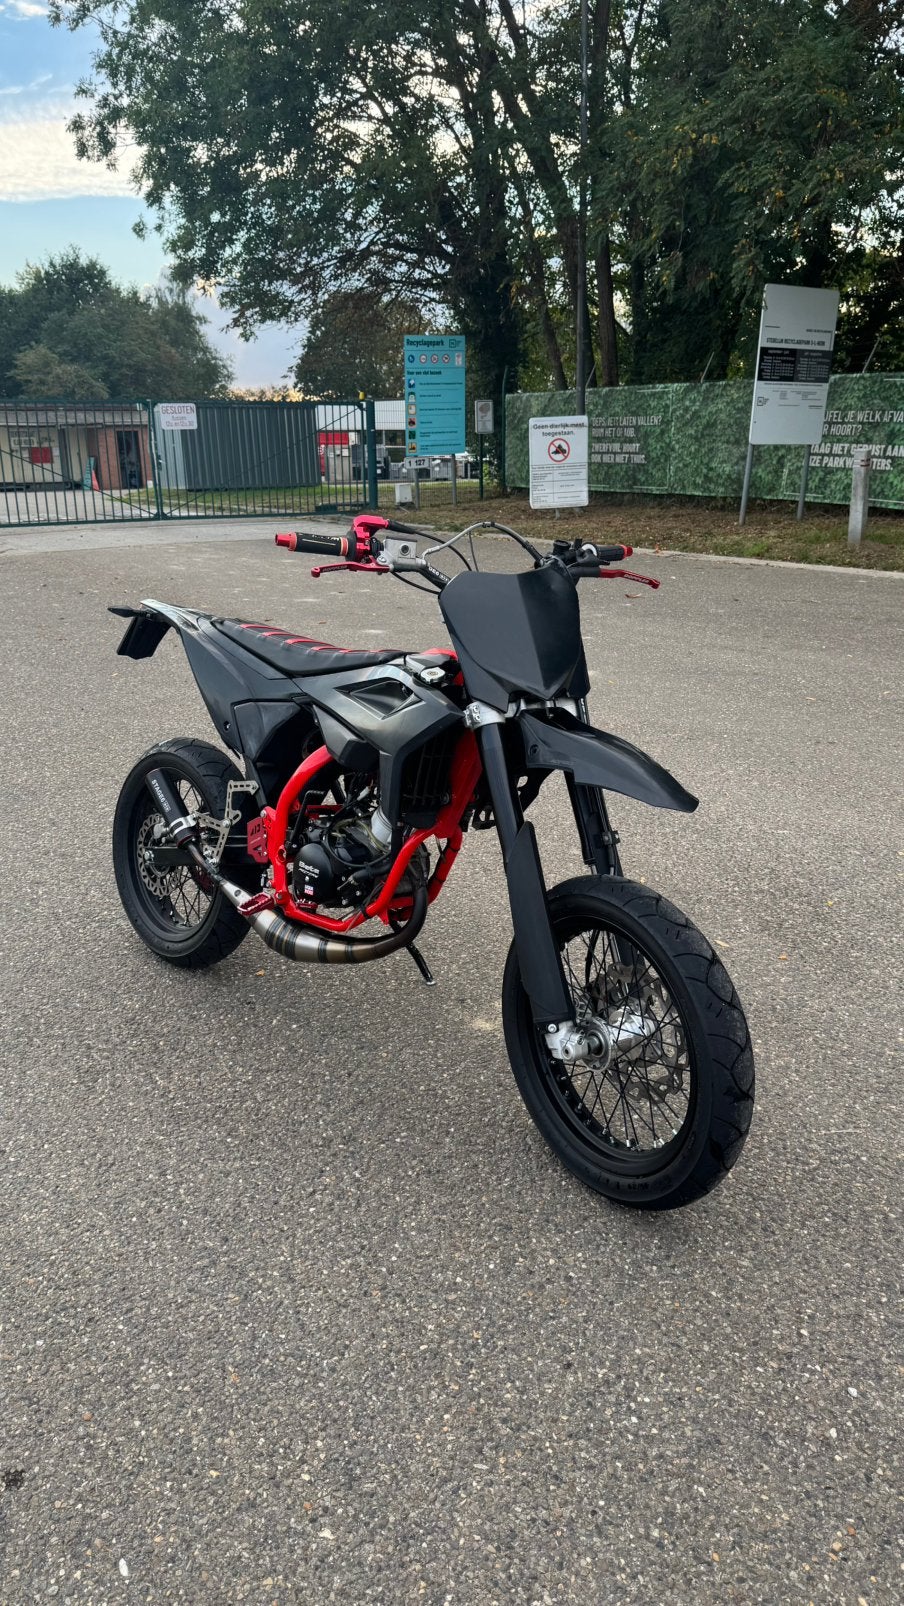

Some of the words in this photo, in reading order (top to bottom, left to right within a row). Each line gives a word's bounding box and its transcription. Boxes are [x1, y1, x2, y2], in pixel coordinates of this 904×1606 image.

[406, 338, 444, 348] Recyclagepark
[161, 405, 195, 415] GESLOTEN
[619, 416, 637, 426] LATEN
[637, 415, 662, 426] VALLEN?
[823, 410, 842, 422] JFEL
[844, 410, 855, 422] JE
[857, 410, 882, 422] WELK
[882, 410, 904, 423] AFVA
[550, 422, 568, 430] dierlijk
[830, 424, 863, 436] HOORT?
[811, 443, 832, 454] AAG
[832, 443, 850, 455] HET
[822, 456, 894, 471] PARKWTERS.
[151, 779, 166, 803] STAGE6
[298, 860, 320, 875] Beta
